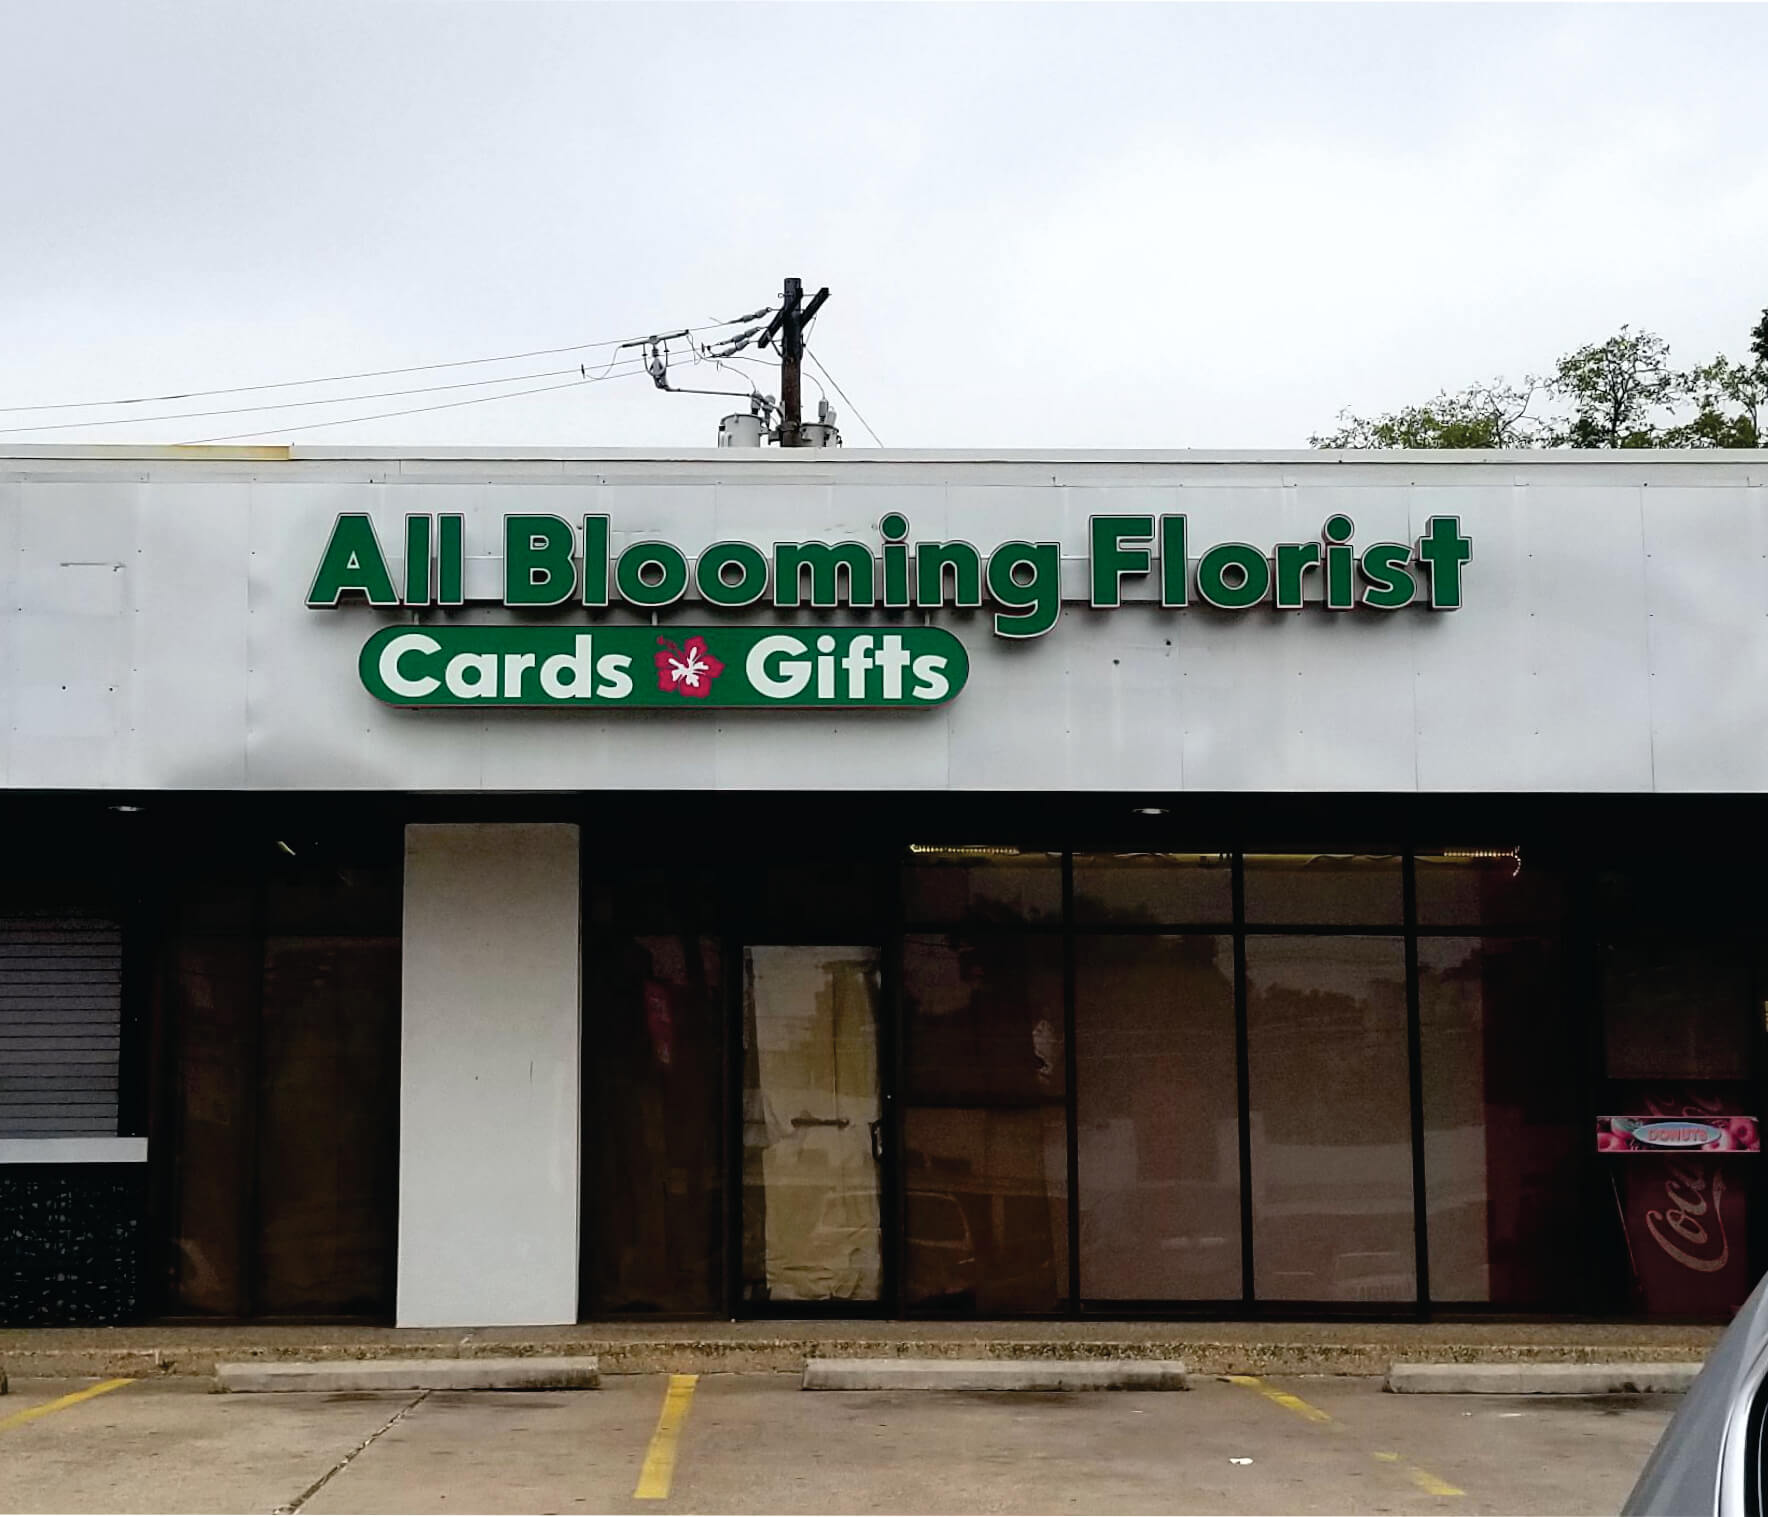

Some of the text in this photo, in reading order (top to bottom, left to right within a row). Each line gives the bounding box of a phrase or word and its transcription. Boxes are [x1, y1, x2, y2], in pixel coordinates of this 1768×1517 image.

[304, 511, 1474, 639] All Blooming Florist
[378, 633, 950, 700] Cards Gifts
[1647, 1127, 1709, 1142] DONUTS
